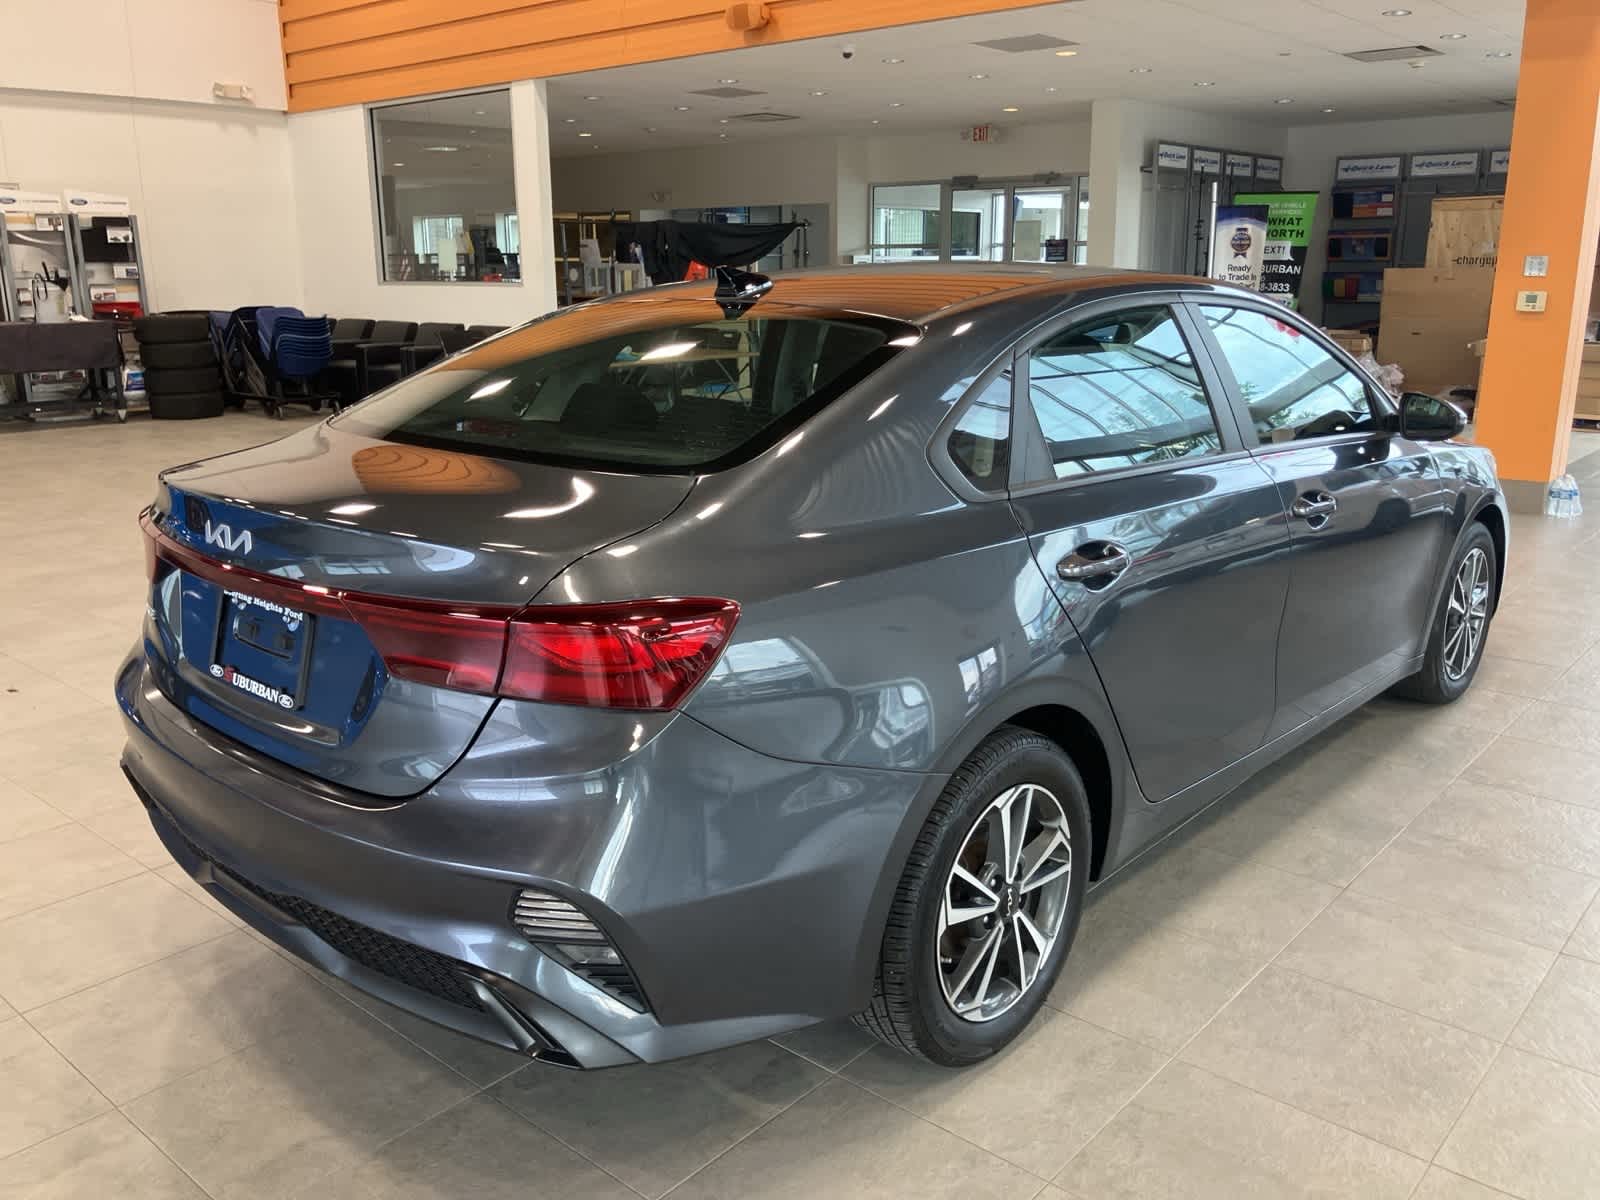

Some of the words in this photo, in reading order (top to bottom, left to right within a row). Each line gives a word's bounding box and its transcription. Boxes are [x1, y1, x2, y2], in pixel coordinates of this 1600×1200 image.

[973, 125, 992, 142] EXIT
[1267, 217, 1303, 226] WHAT
[1263, 246, 1286, 255] EXT!
[1227, 264, 1251, 275] Ready
[1260, 264, 1301, 275] BURBAN
[1228, 272, 1249, 281] Trade
[1260, 282, 1291, 293] 8-3833
[253, 597, 283, 615] Heights
[284, 607, 304, 621] Ford
[223, 666, 279, 703] SUBURBAN
